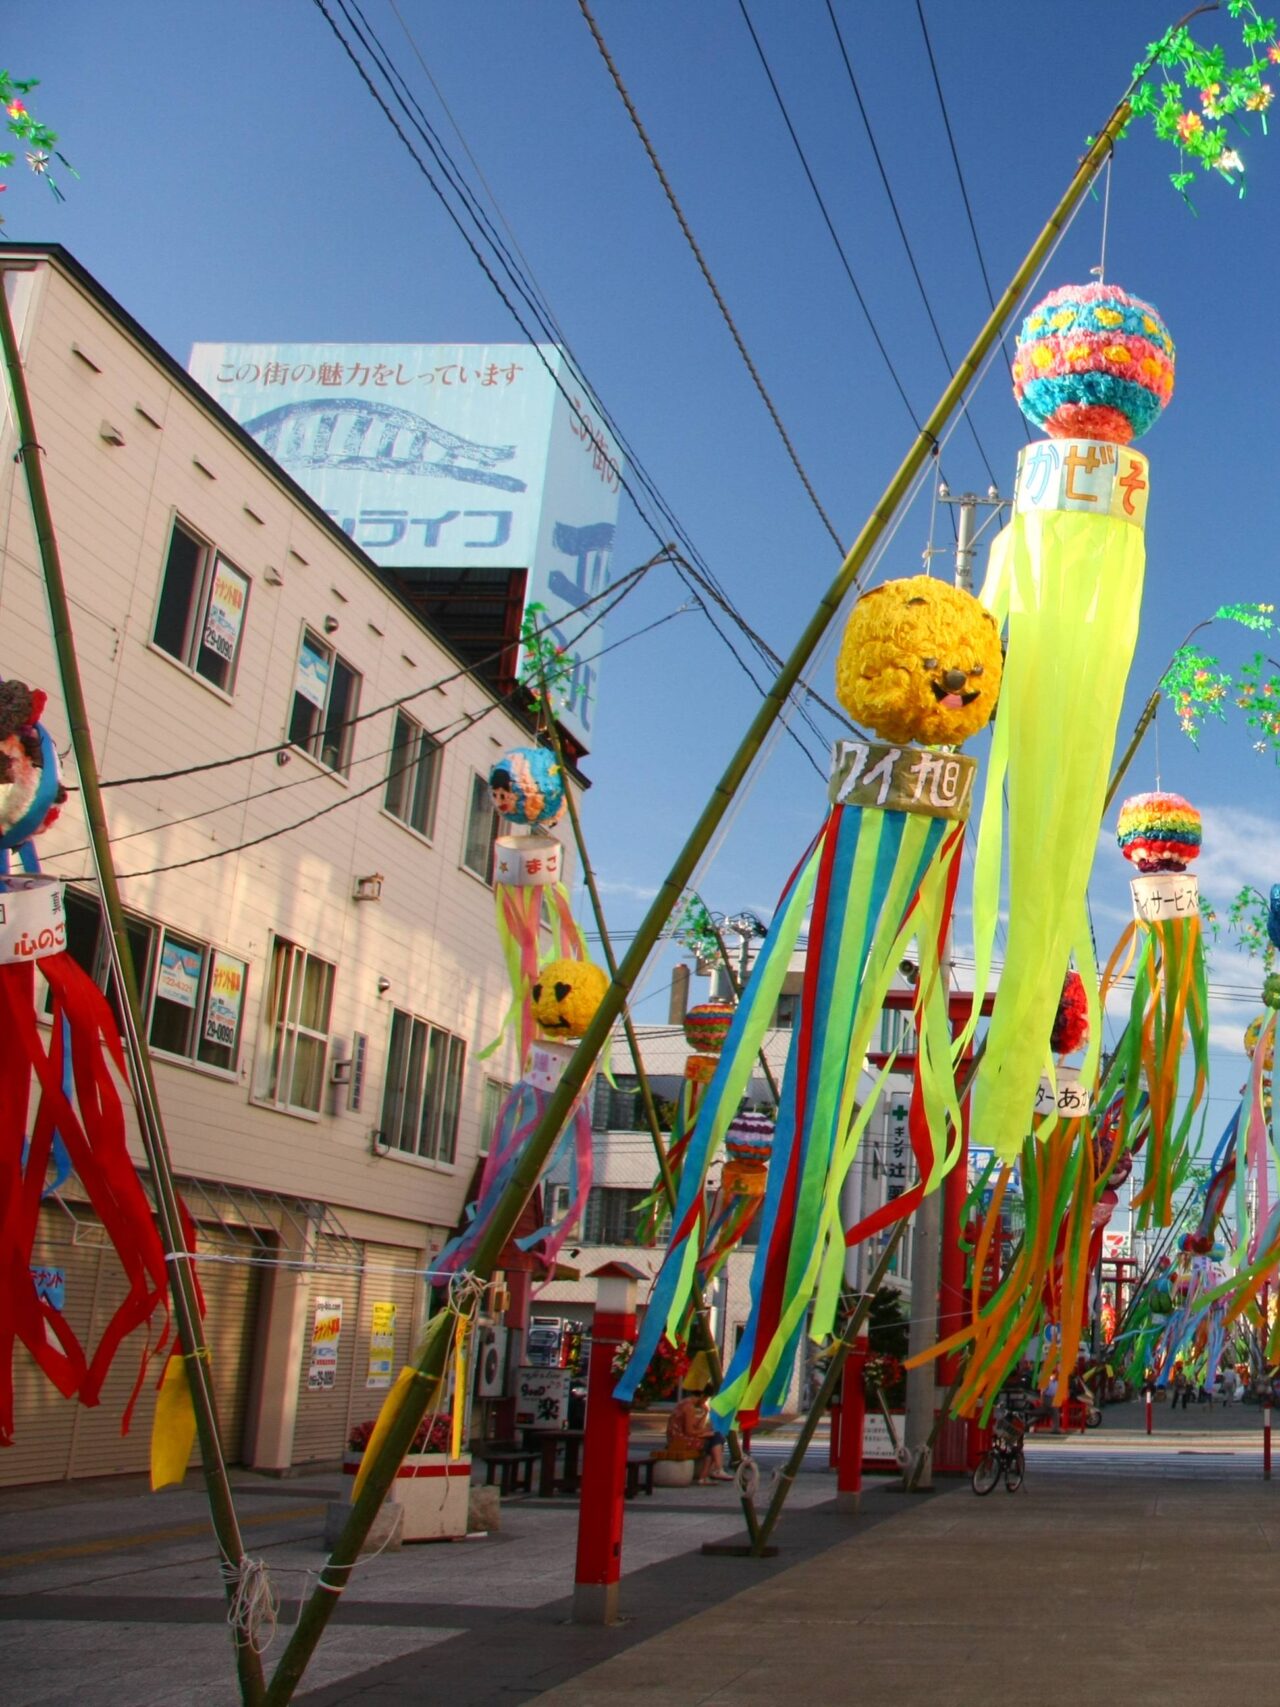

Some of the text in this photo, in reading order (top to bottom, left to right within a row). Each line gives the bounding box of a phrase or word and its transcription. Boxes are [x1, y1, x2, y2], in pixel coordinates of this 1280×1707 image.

[215, 361, 524, 387] この街の魅力をしっています
